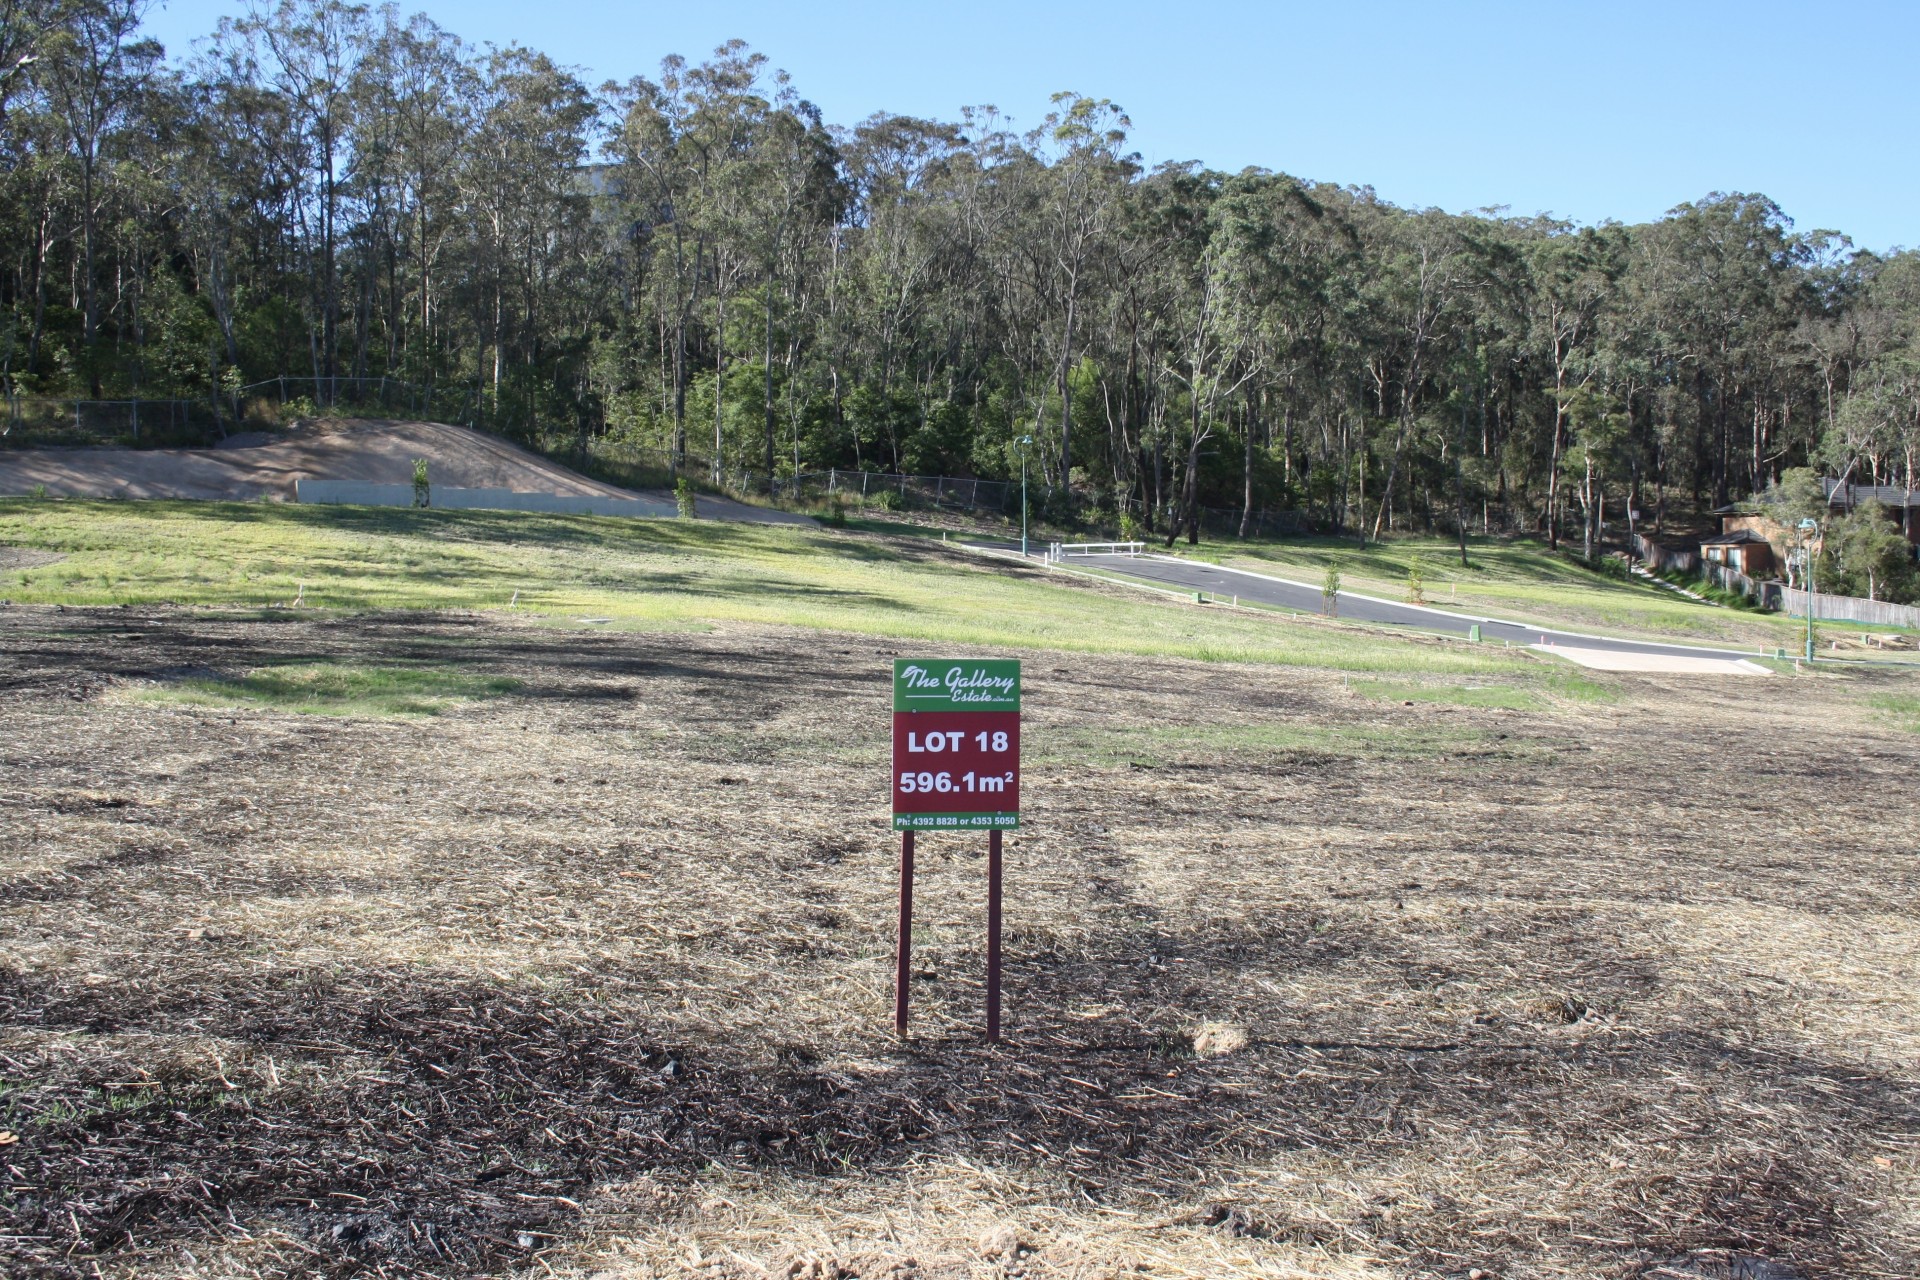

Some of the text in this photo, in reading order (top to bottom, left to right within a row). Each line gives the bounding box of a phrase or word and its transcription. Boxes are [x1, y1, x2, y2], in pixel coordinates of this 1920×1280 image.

[902, 666, 1015, 694] The Gallery
[908, 731, 1009, 753] LOT 18
[896, 818, 911, 826] Ph:
[912, 817, 934, 826] 4392
[936, 817, 958, 826] 8828
[970, 816, 992, 825] 4353
[994, 816, 1016, 825] 5050
